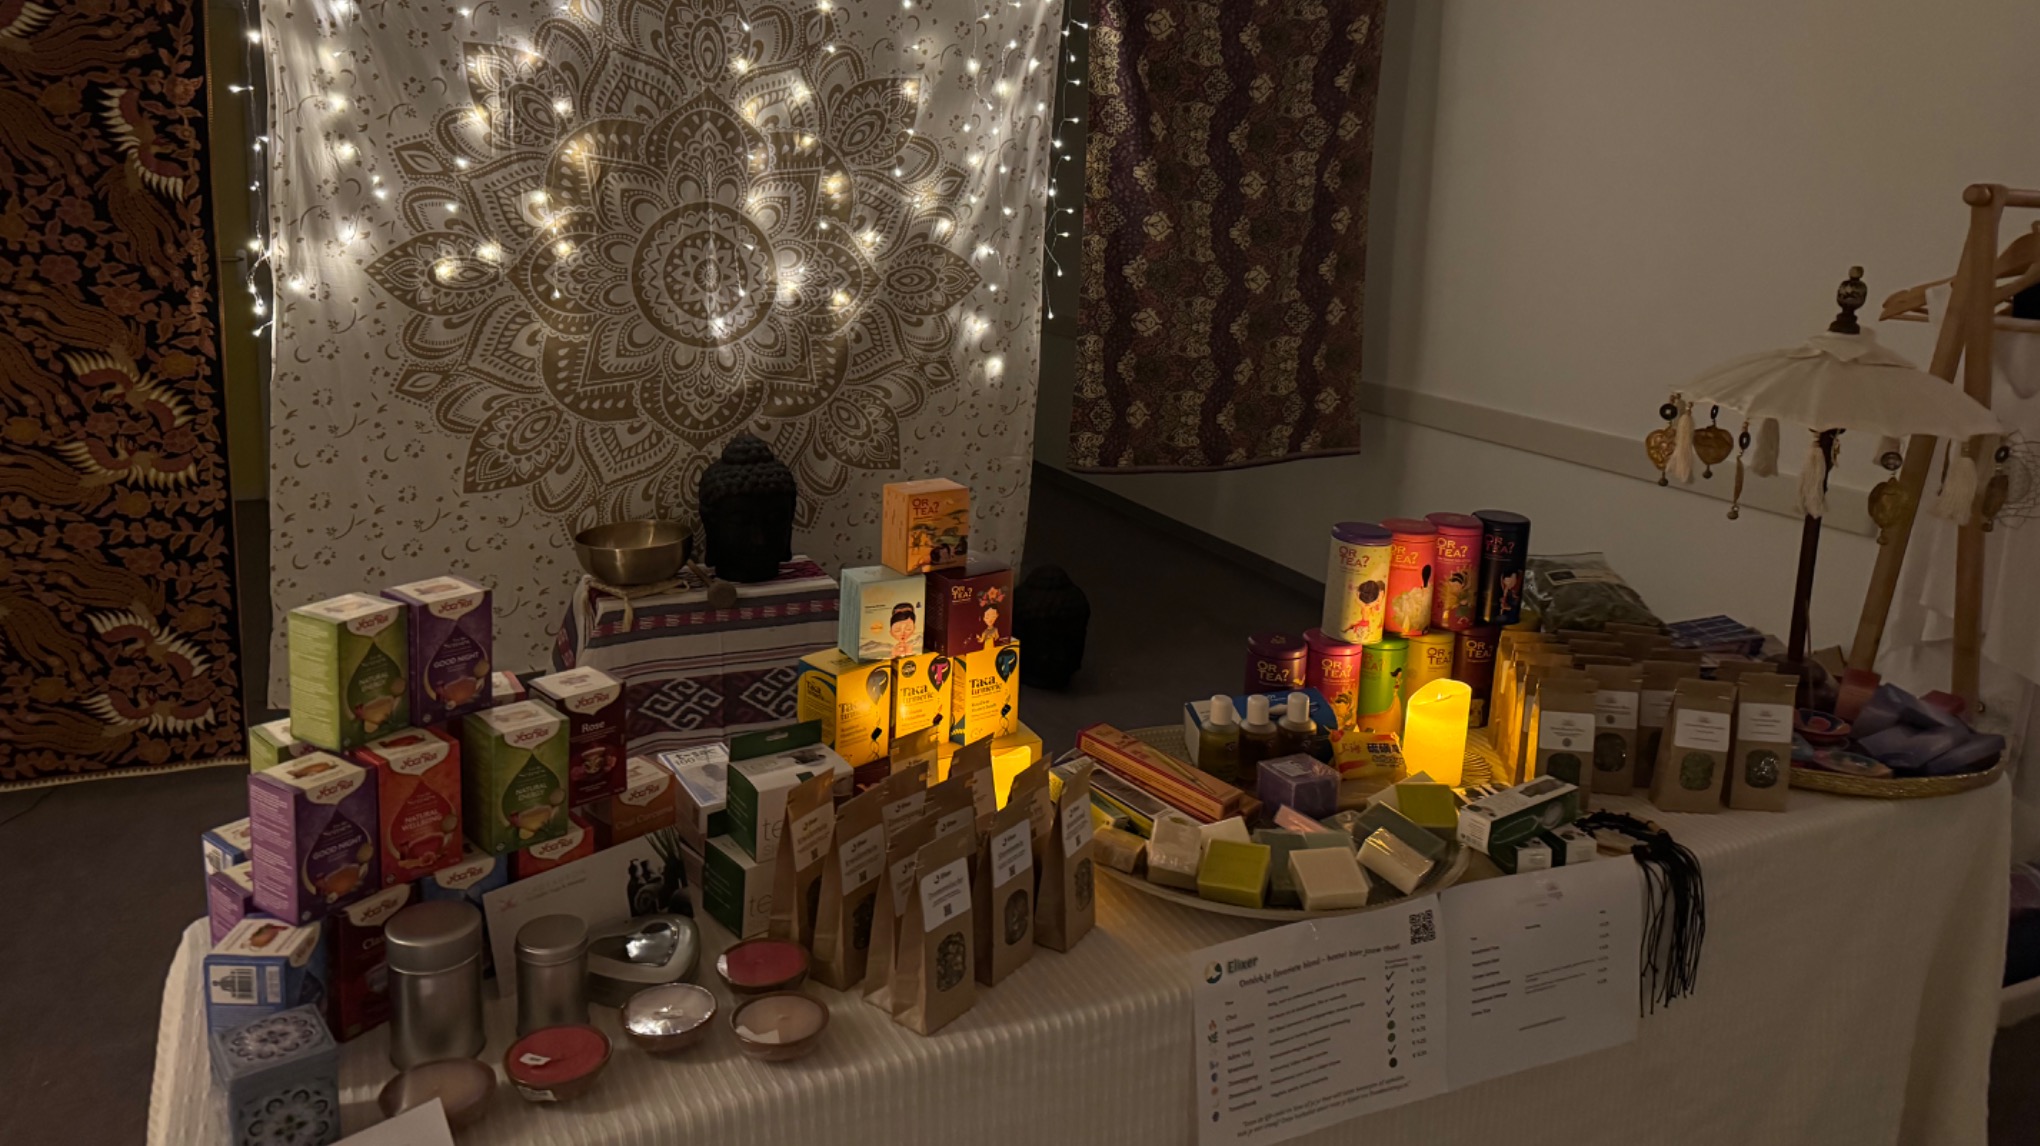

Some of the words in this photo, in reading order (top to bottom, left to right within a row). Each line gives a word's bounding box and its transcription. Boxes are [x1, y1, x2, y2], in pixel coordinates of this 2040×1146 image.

[912, 498, 930, 508] OR
[913, 501, 939, 516] TEA?
[1436, 537, 1456, 549] OR
[1485, 534, 1504, 546] OR
[1338, 546, 1357, 557] OR
[1437, 545, 1469, 558] TEA?
[1486, 540, 1516, 555] TEA?
[1339, 553, 1370, 567] TEA?
[1395, 551, 1418, 564] EA?
[1427, 647, 1445, 657] OR
[1466, 641, 1486, 650] OR
[433, 657, 457, 668] GOOD
[457, 651, 479, 664] NIGHT
[1321, 659, 1342, 669] OR
[1257, 661, 1278, 672] OR
[1322, 665, 1353, 678] TEA?
[1258, 668, 1290, 683] TEA?
[969, 677, 995, 690] Taka
[581, 722, 605, 733] Rose
[312, 846, 338, 860] GOOD
[338, 835, 362, 852] NIGHT
[1227, 956, 1258, 974] Elixer
